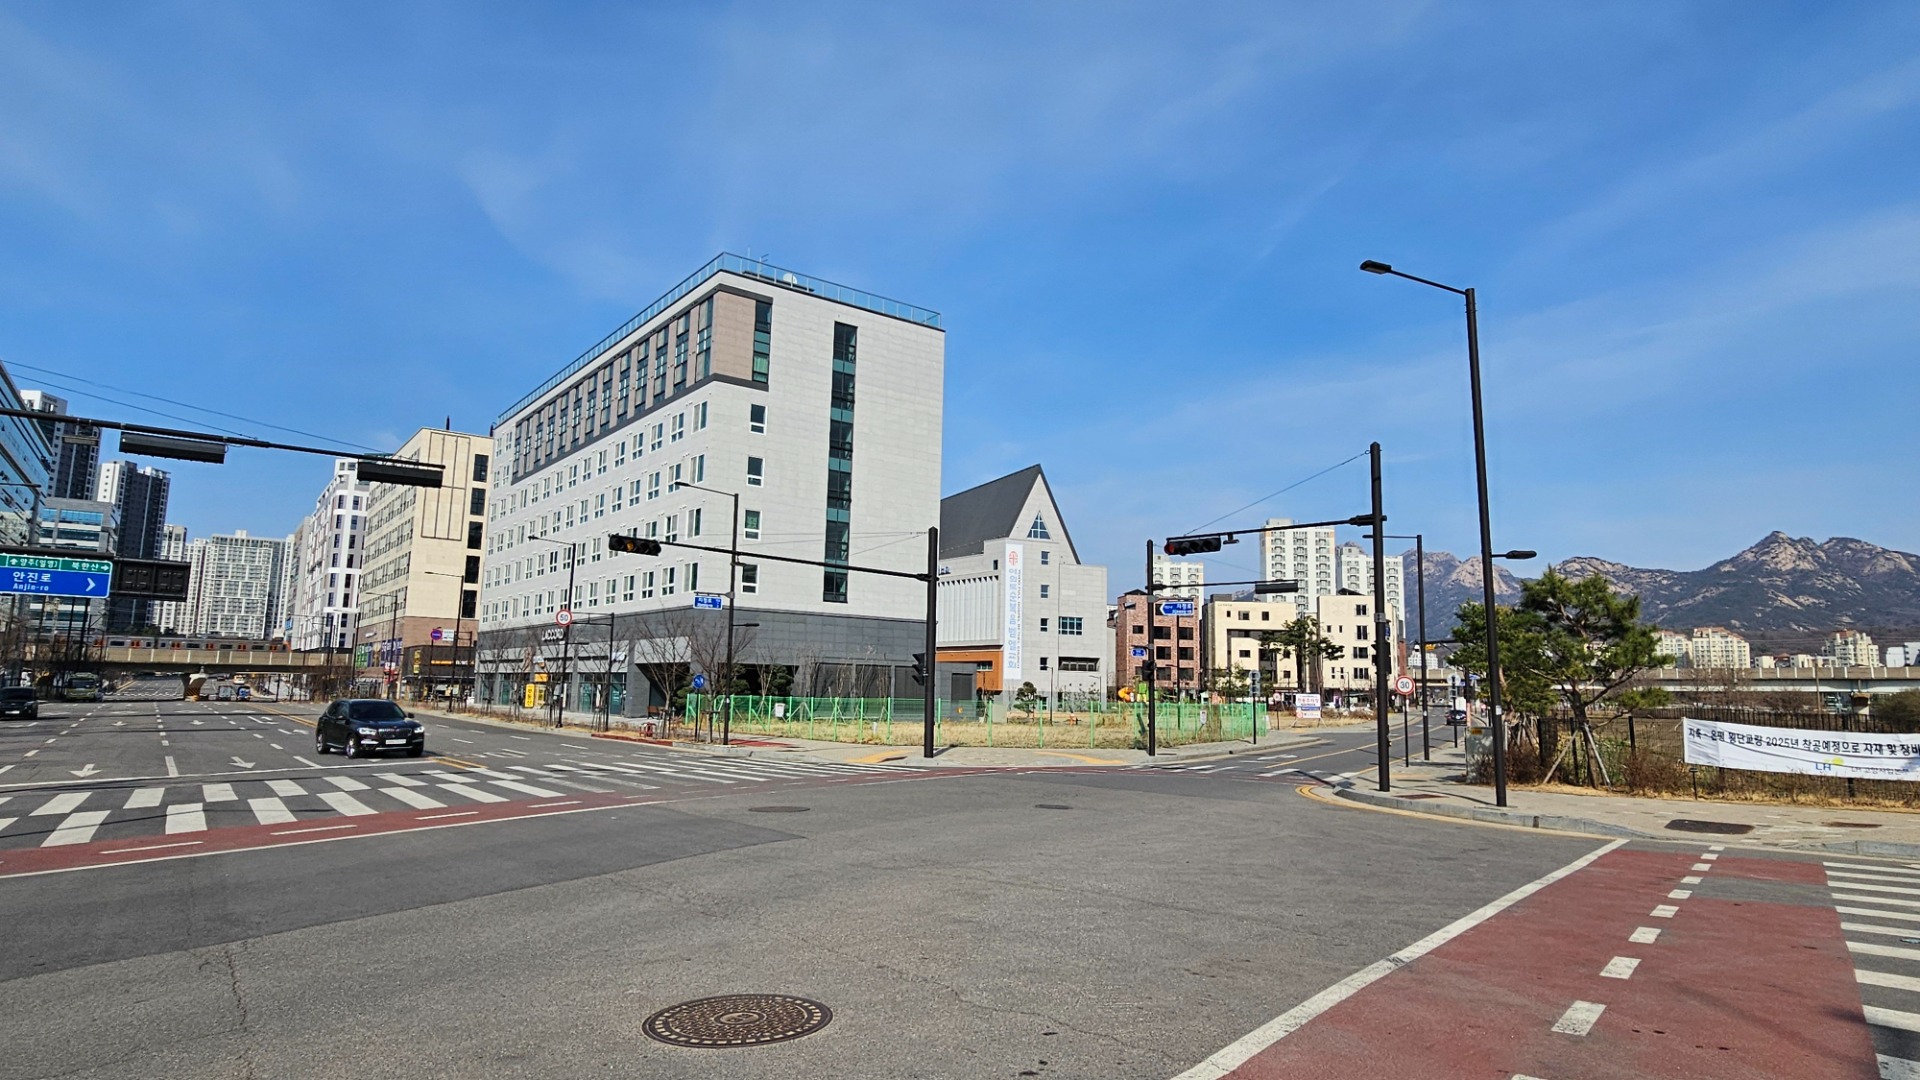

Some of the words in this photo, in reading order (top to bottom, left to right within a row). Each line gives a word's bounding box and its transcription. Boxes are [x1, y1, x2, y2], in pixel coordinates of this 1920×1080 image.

[71, 562, 99, 571] 북한산
[13, 571, 52, 583] 안진로
[13, 583, 49, 591] Anjin-ro
[1400, 681, 1410, 689] 30
[1728, 731, 1763, 747] 횡단교량
[1765, 736, 1799, 748] 2025년
[1802, 739, 1861, 754] 착공예정으로
[1863, 743, 1883, 755] 자재
[1887, 743, 1897, 755] 및
[1815, 763, 1831, 771] LH
